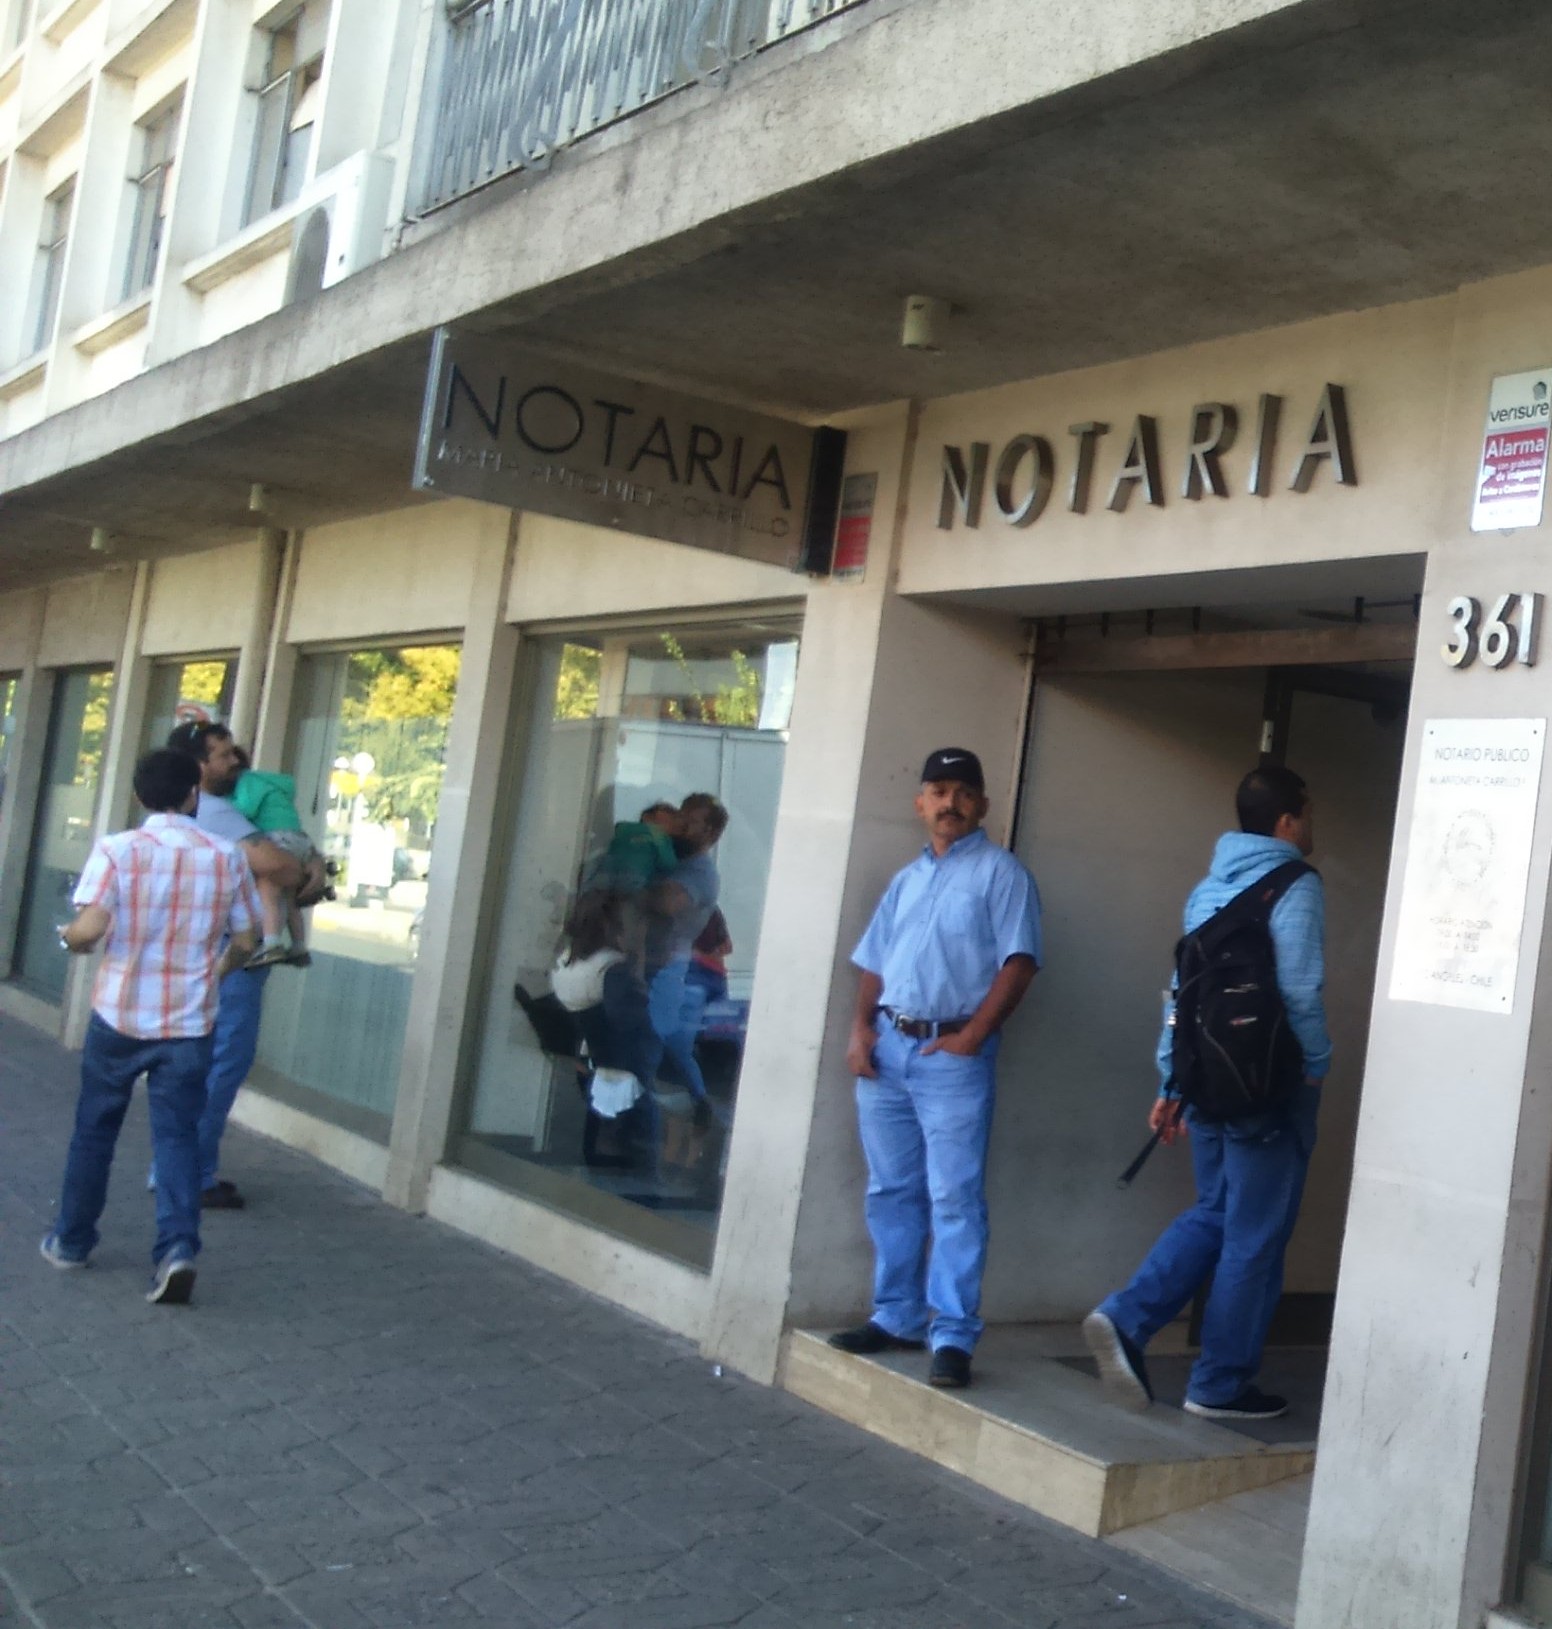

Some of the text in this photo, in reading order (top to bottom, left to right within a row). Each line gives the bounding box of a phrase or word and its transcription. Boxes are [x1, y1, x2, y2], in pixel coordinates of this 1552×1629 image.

[443, 362, 791, 510] NOTARIA
[1490, 402, 1550, 423] verisure
[936, 382, 1358, 530] NOTARIA
[1486, 437, 1545, 460] Alarma
[1440, 593, 1544, 669] 361
[1434, 747, 1482, 761] NOTARIO
